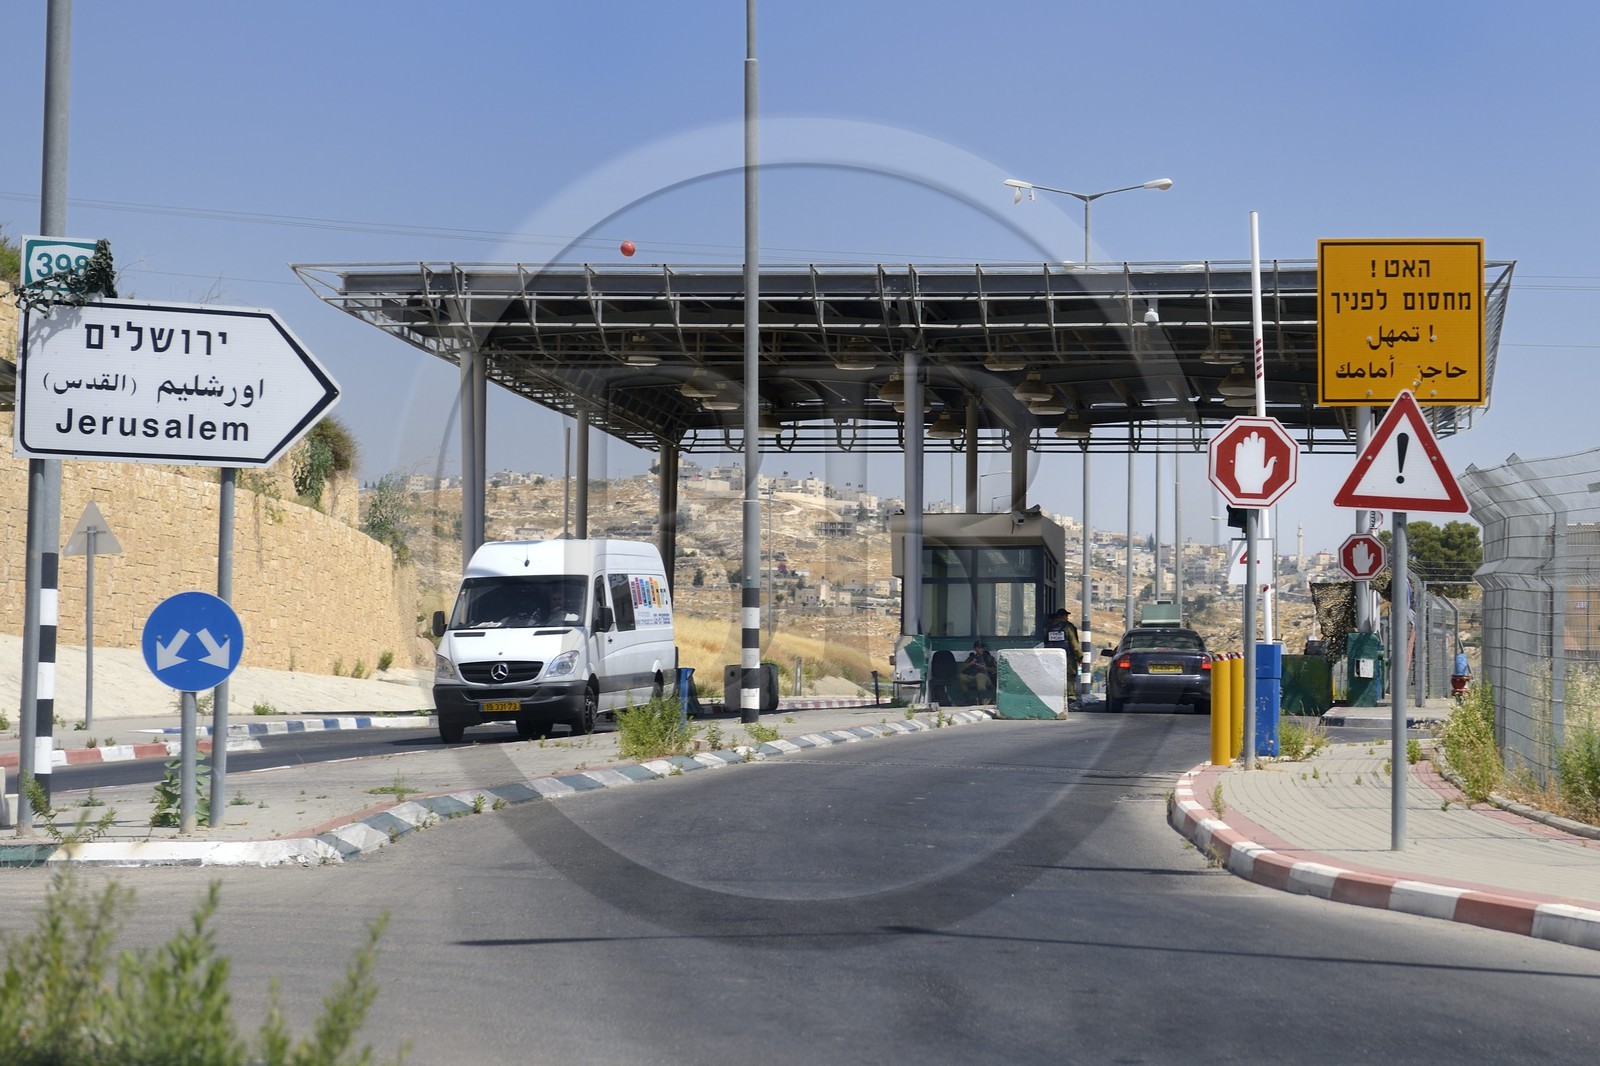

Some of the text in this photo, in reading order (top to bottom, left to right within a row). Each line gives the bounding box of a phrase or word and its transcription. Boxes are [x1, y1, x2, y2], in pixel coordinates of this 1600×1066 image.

[1331, 289, 1471, 314] מחסום לפניך
[84, 321, 227, 356] ירושלים
[1336, 355, 1467, 383] حاجز أمامك
[55, 408, 249, 441] Jerusalem
